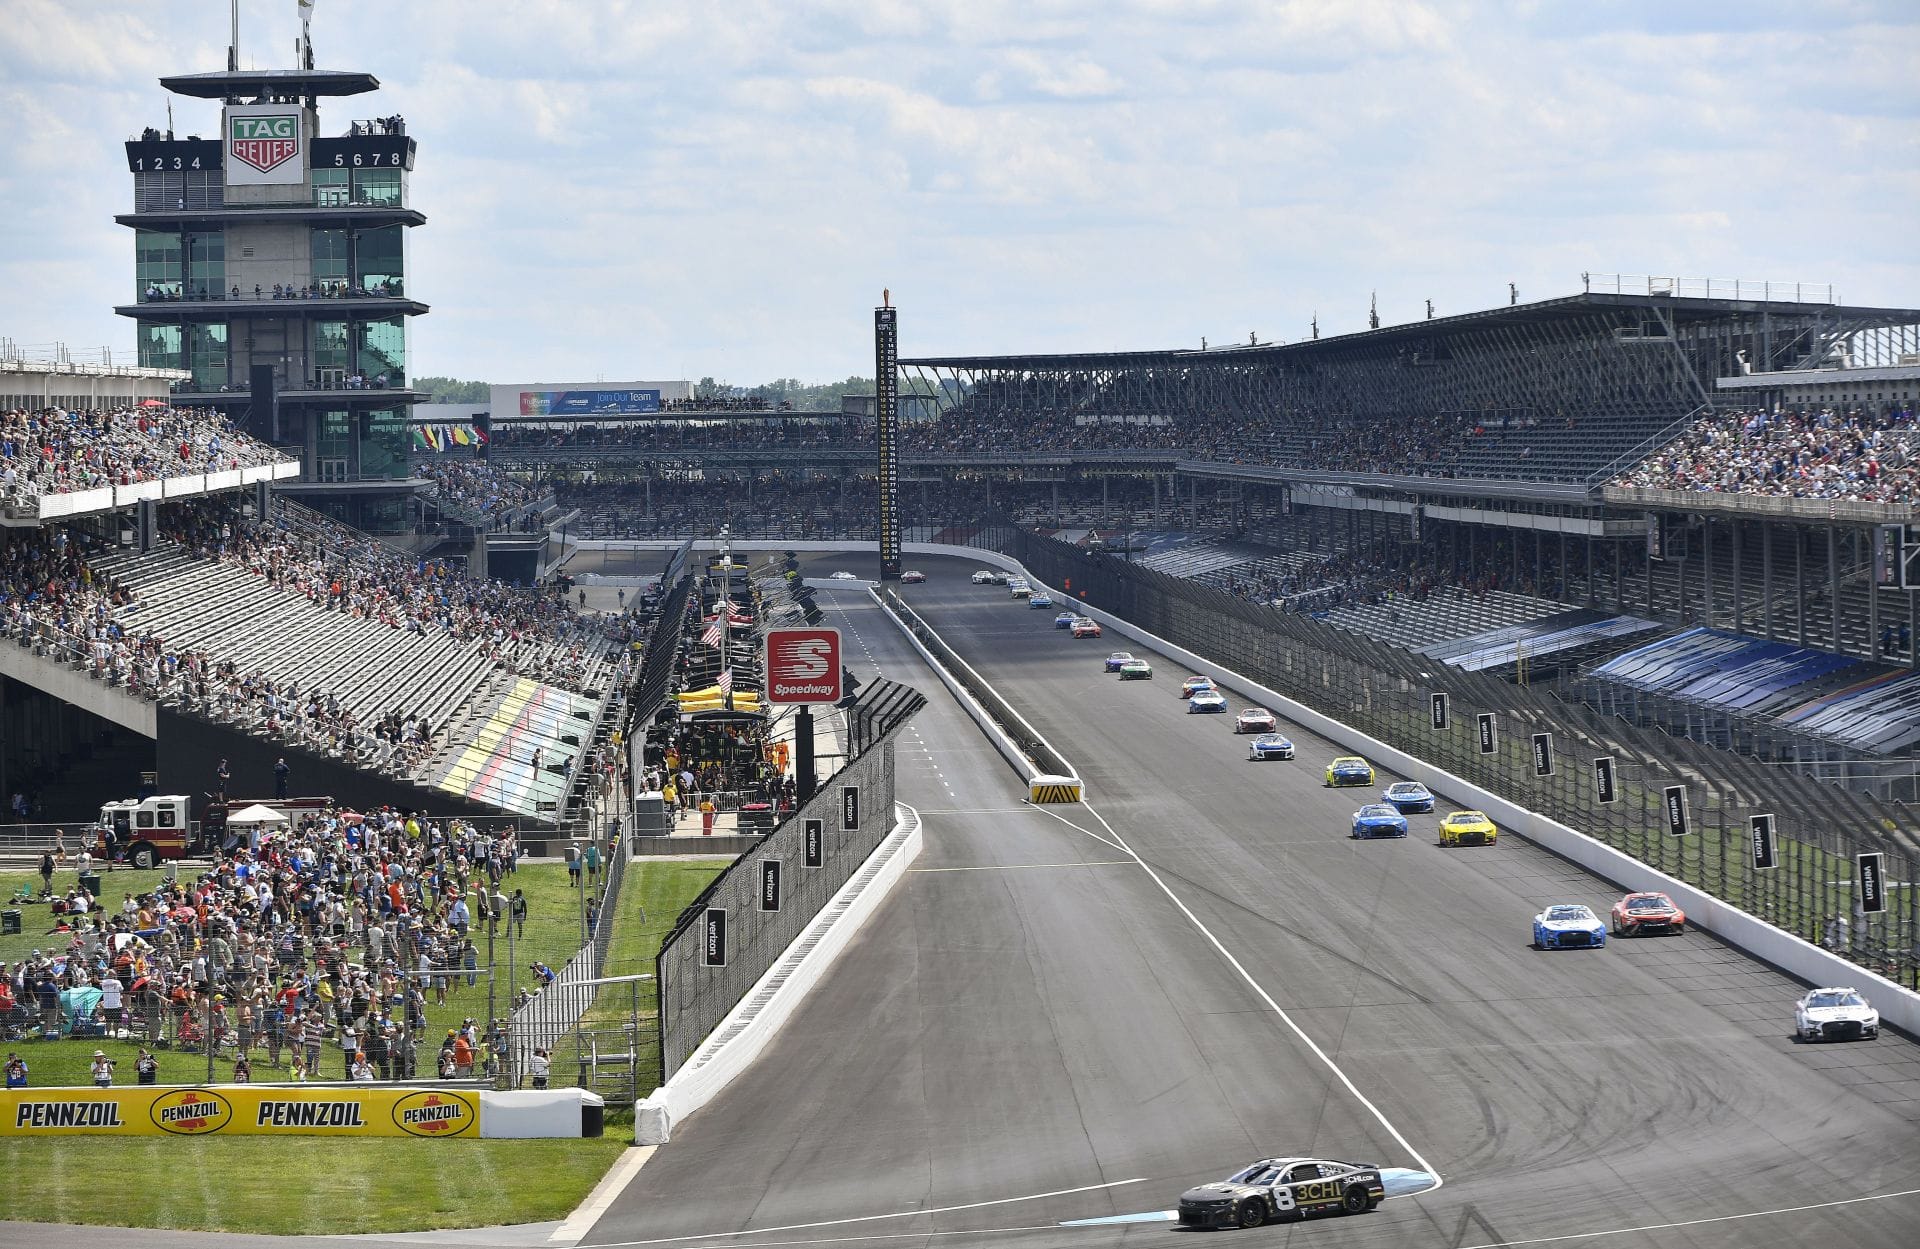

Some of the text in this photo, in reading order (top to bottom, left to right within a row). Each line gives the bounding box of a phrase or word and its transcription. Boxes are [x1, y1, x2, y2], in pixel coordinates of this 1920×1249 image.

[237, 120, 291, 137] TAG
[136, 157, 200, 170] 1 2 3 4
[236, 141, 293, 167] HEUER
[334, 153, 399, 166] 5 6 7 8
[630, 392, 651, 401] Team
[774, 684, 834, 696] Speedway
[1670, 796, 1680, 825] verizon
[1754, 827, 1763, 858] verizon
[767, 870, 775, 901] verizon
[1864, 866, 1874, 900] verizon
[709, 921, 719, 955] verizon
[16, 1102, 120, 1128] PENNZOIL
[161, 1102, 220, 1122] PENNZOIL
[257, 1101, 364, 1126] PENNZOIL
[404, 1104, 462, 1124] PENNZOIL
[1273, 1186, 1296, 1210] 8
[1297, 1182, 1342, 1200] 3CHI
